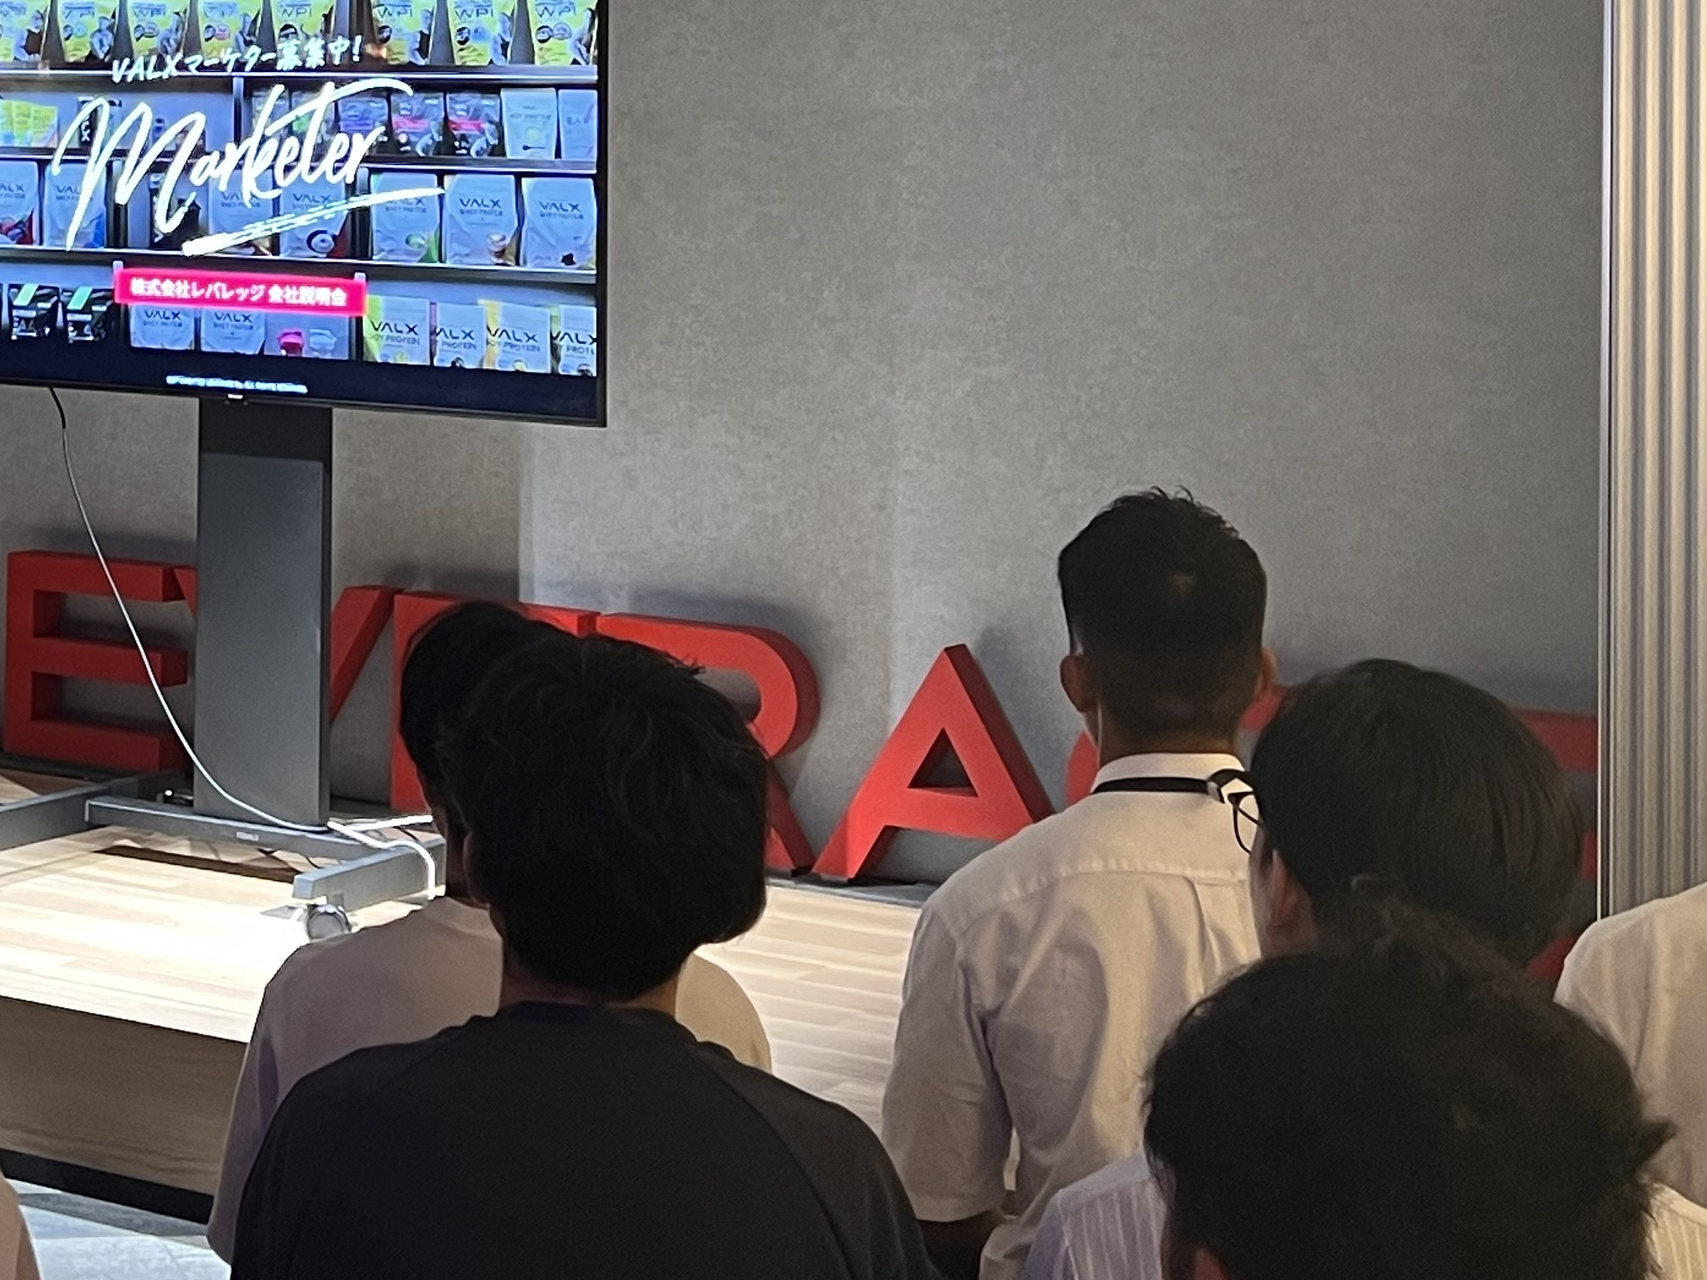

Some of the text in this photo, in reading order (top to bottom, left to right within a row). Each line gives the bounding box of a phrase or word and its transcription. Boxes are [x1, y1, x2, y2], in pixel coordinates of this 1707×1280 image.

[52, 78, 413, 251] Marketer
[459, 198, 503, 209] VALX
[539, 201, 582, 213] VALX
[144, 309, 182, 321] VALX
[214, 312, 253, 324] VALX
[370, 320, 419, 336] VALX
[487, 325, 538, 343] VALX
